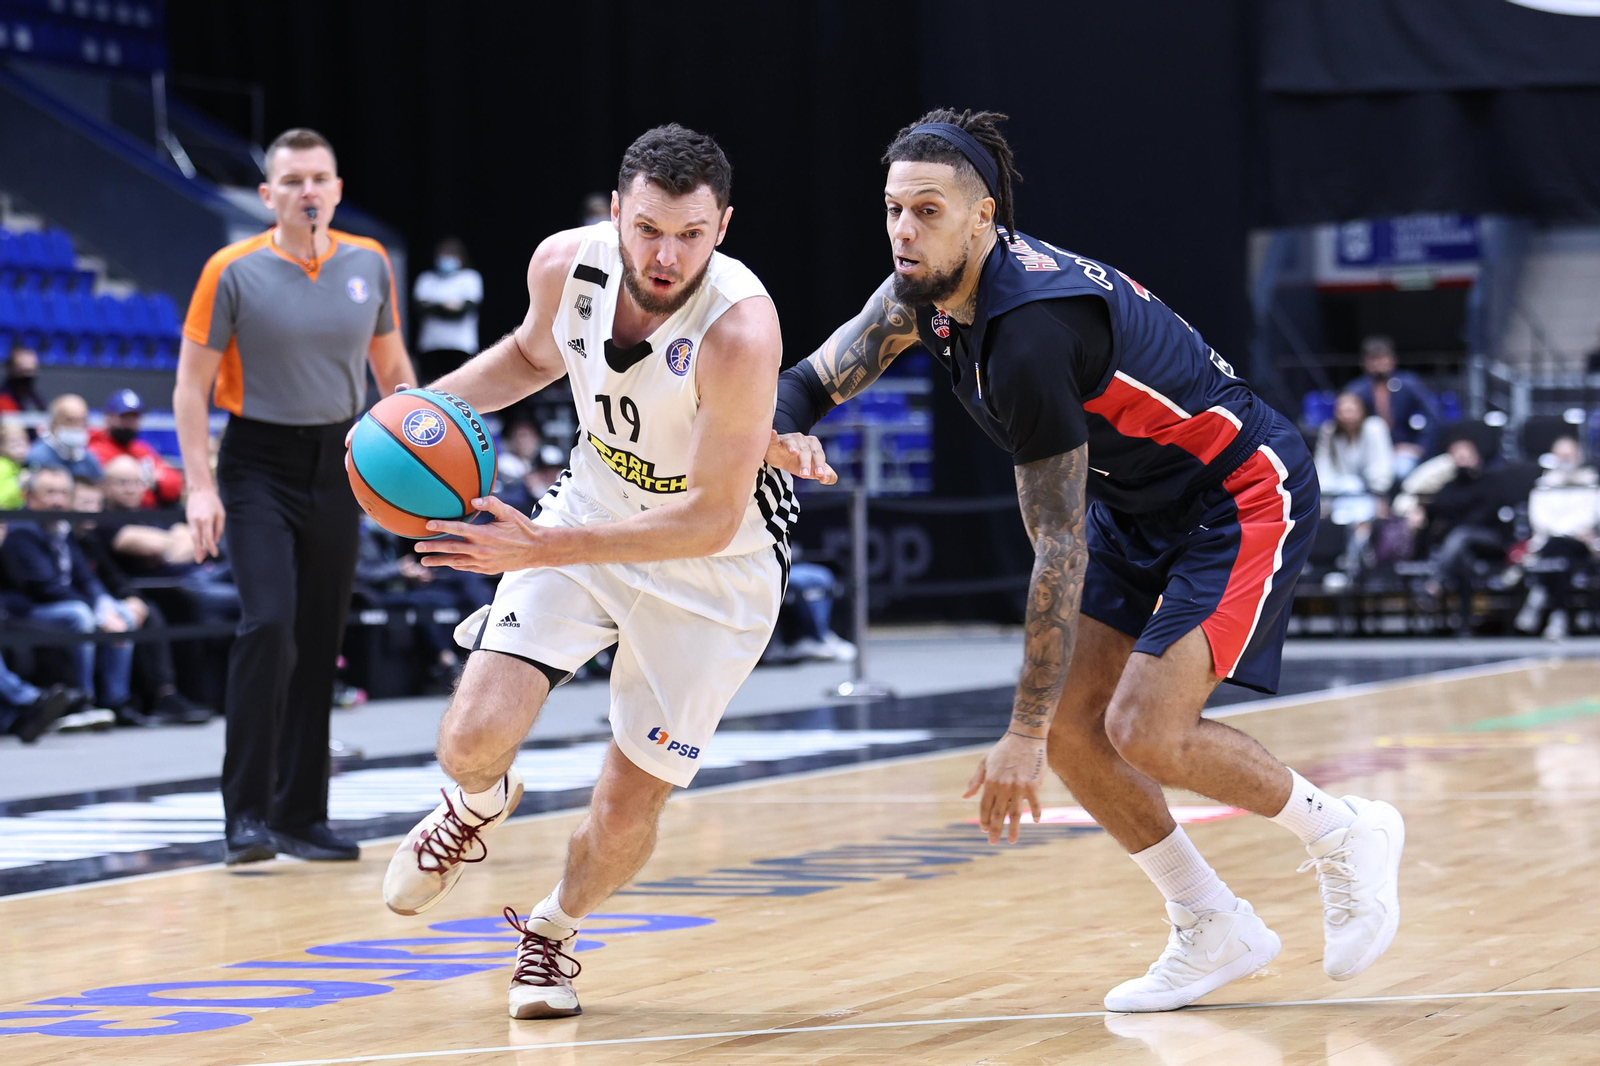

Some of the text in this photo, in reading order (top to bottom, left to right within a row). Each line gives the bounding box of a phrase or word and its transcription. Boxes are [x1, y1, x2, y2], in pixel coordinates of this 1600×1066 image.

[567, 340, 587, 359] adidas
[595, 394, 640, 443] 19
[601, 453, 687, 492] MATCH
[667, 740, 700, 759] PSB
